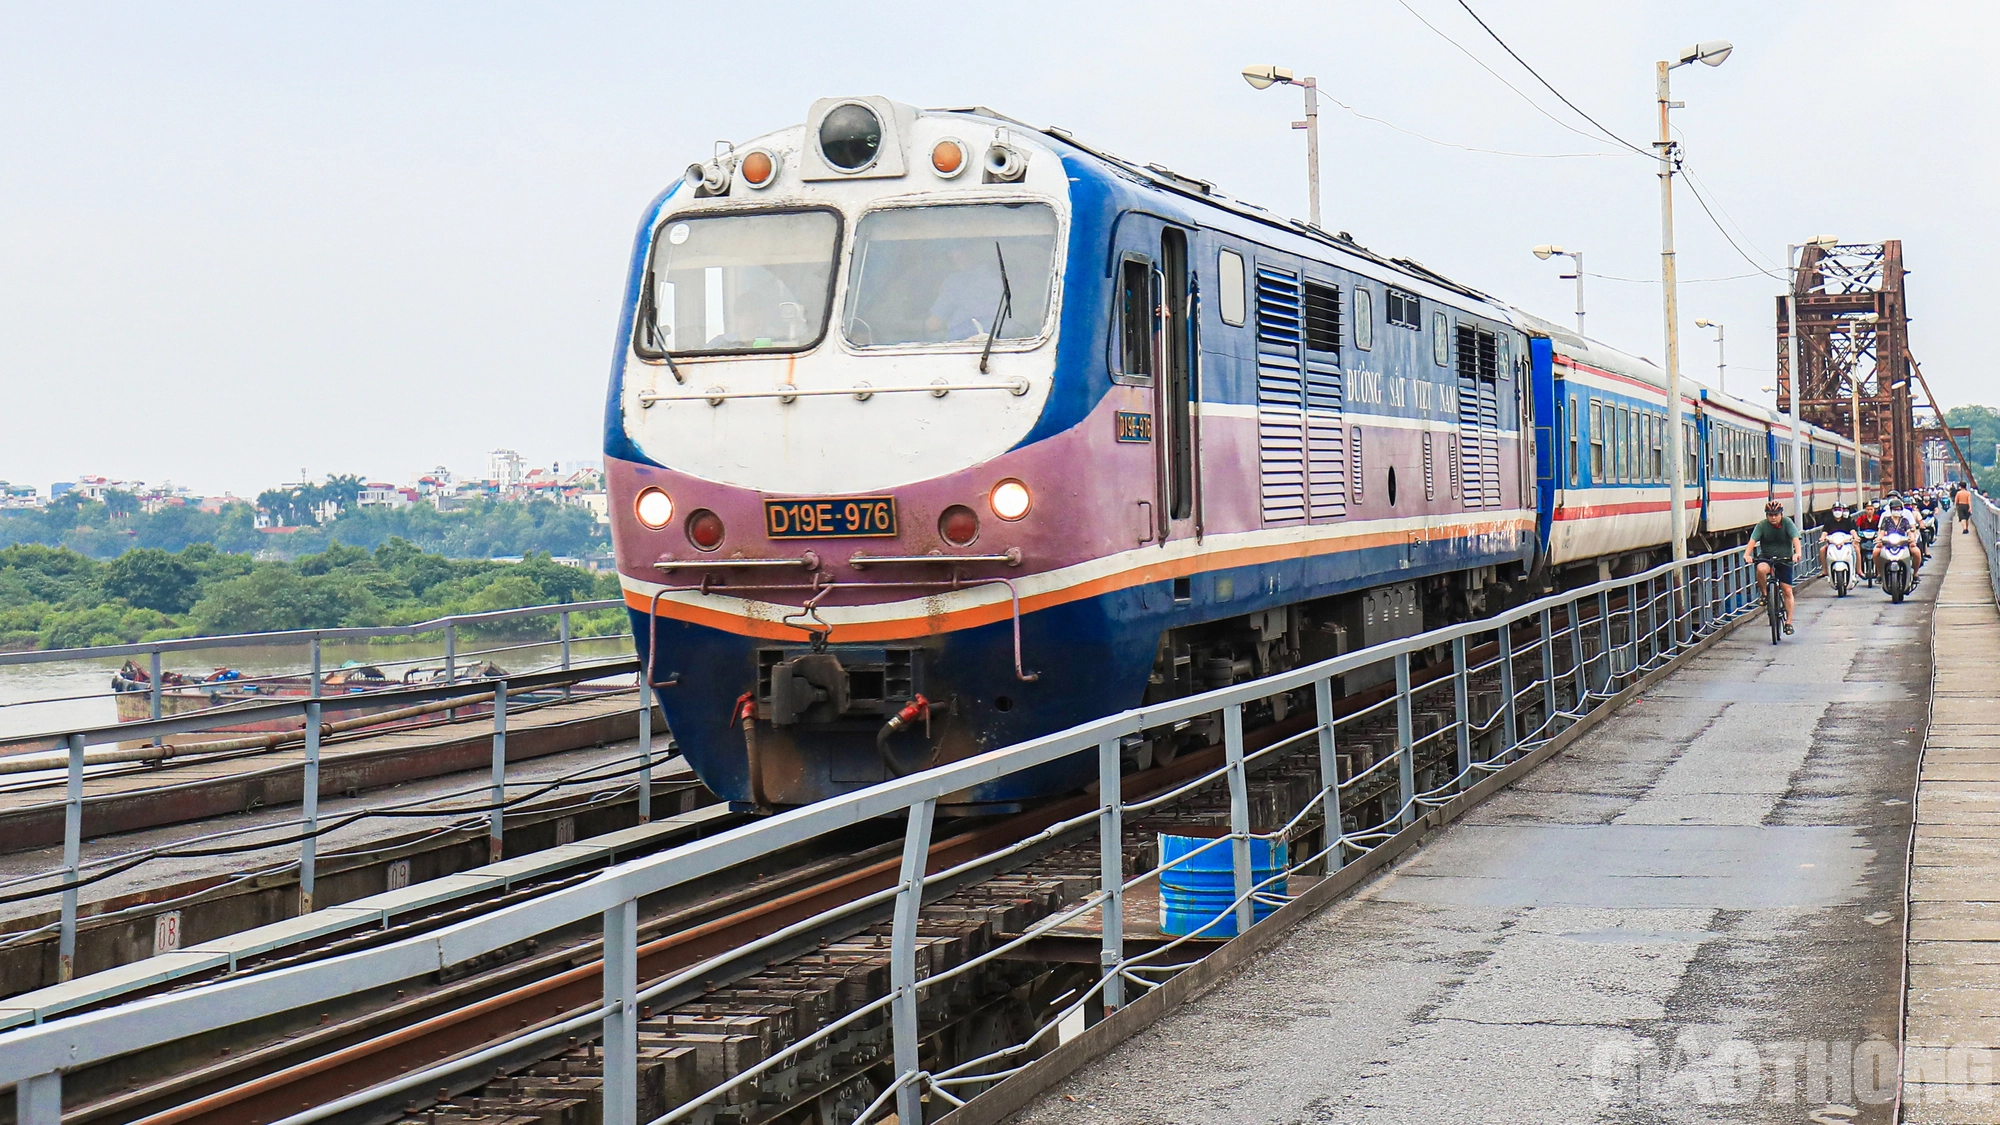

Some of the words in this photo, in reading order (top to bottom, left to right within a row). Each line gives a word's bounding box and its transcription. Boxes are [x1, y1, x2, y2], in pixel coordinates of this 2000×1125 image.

[1346, 361, 1382, 404] ĐƯỜNG
[1439, 383, 1457, 414] NAM
[769, 502, 890, 533] D19E-976
